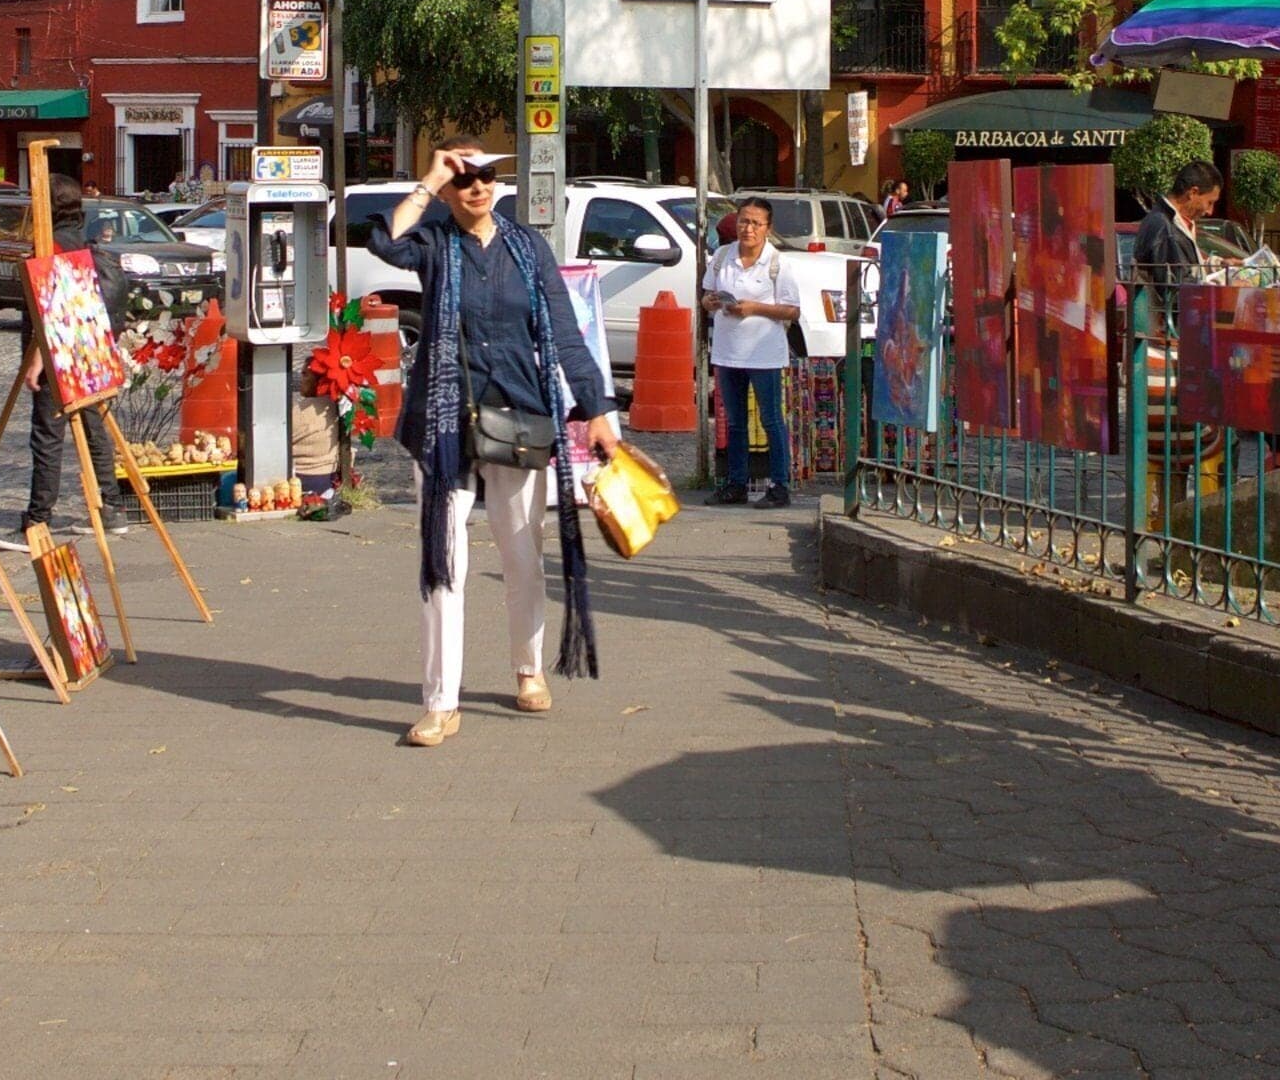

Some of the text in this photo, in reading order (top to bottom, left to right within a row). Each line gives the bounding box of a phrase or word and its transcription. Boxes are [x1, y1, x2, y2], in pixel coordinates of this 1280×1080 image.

[273, 0, 322, 10] AHORRA
[955, 131, 1048, 148] BARBACOA
[1051, 130, 1064, 146] de
